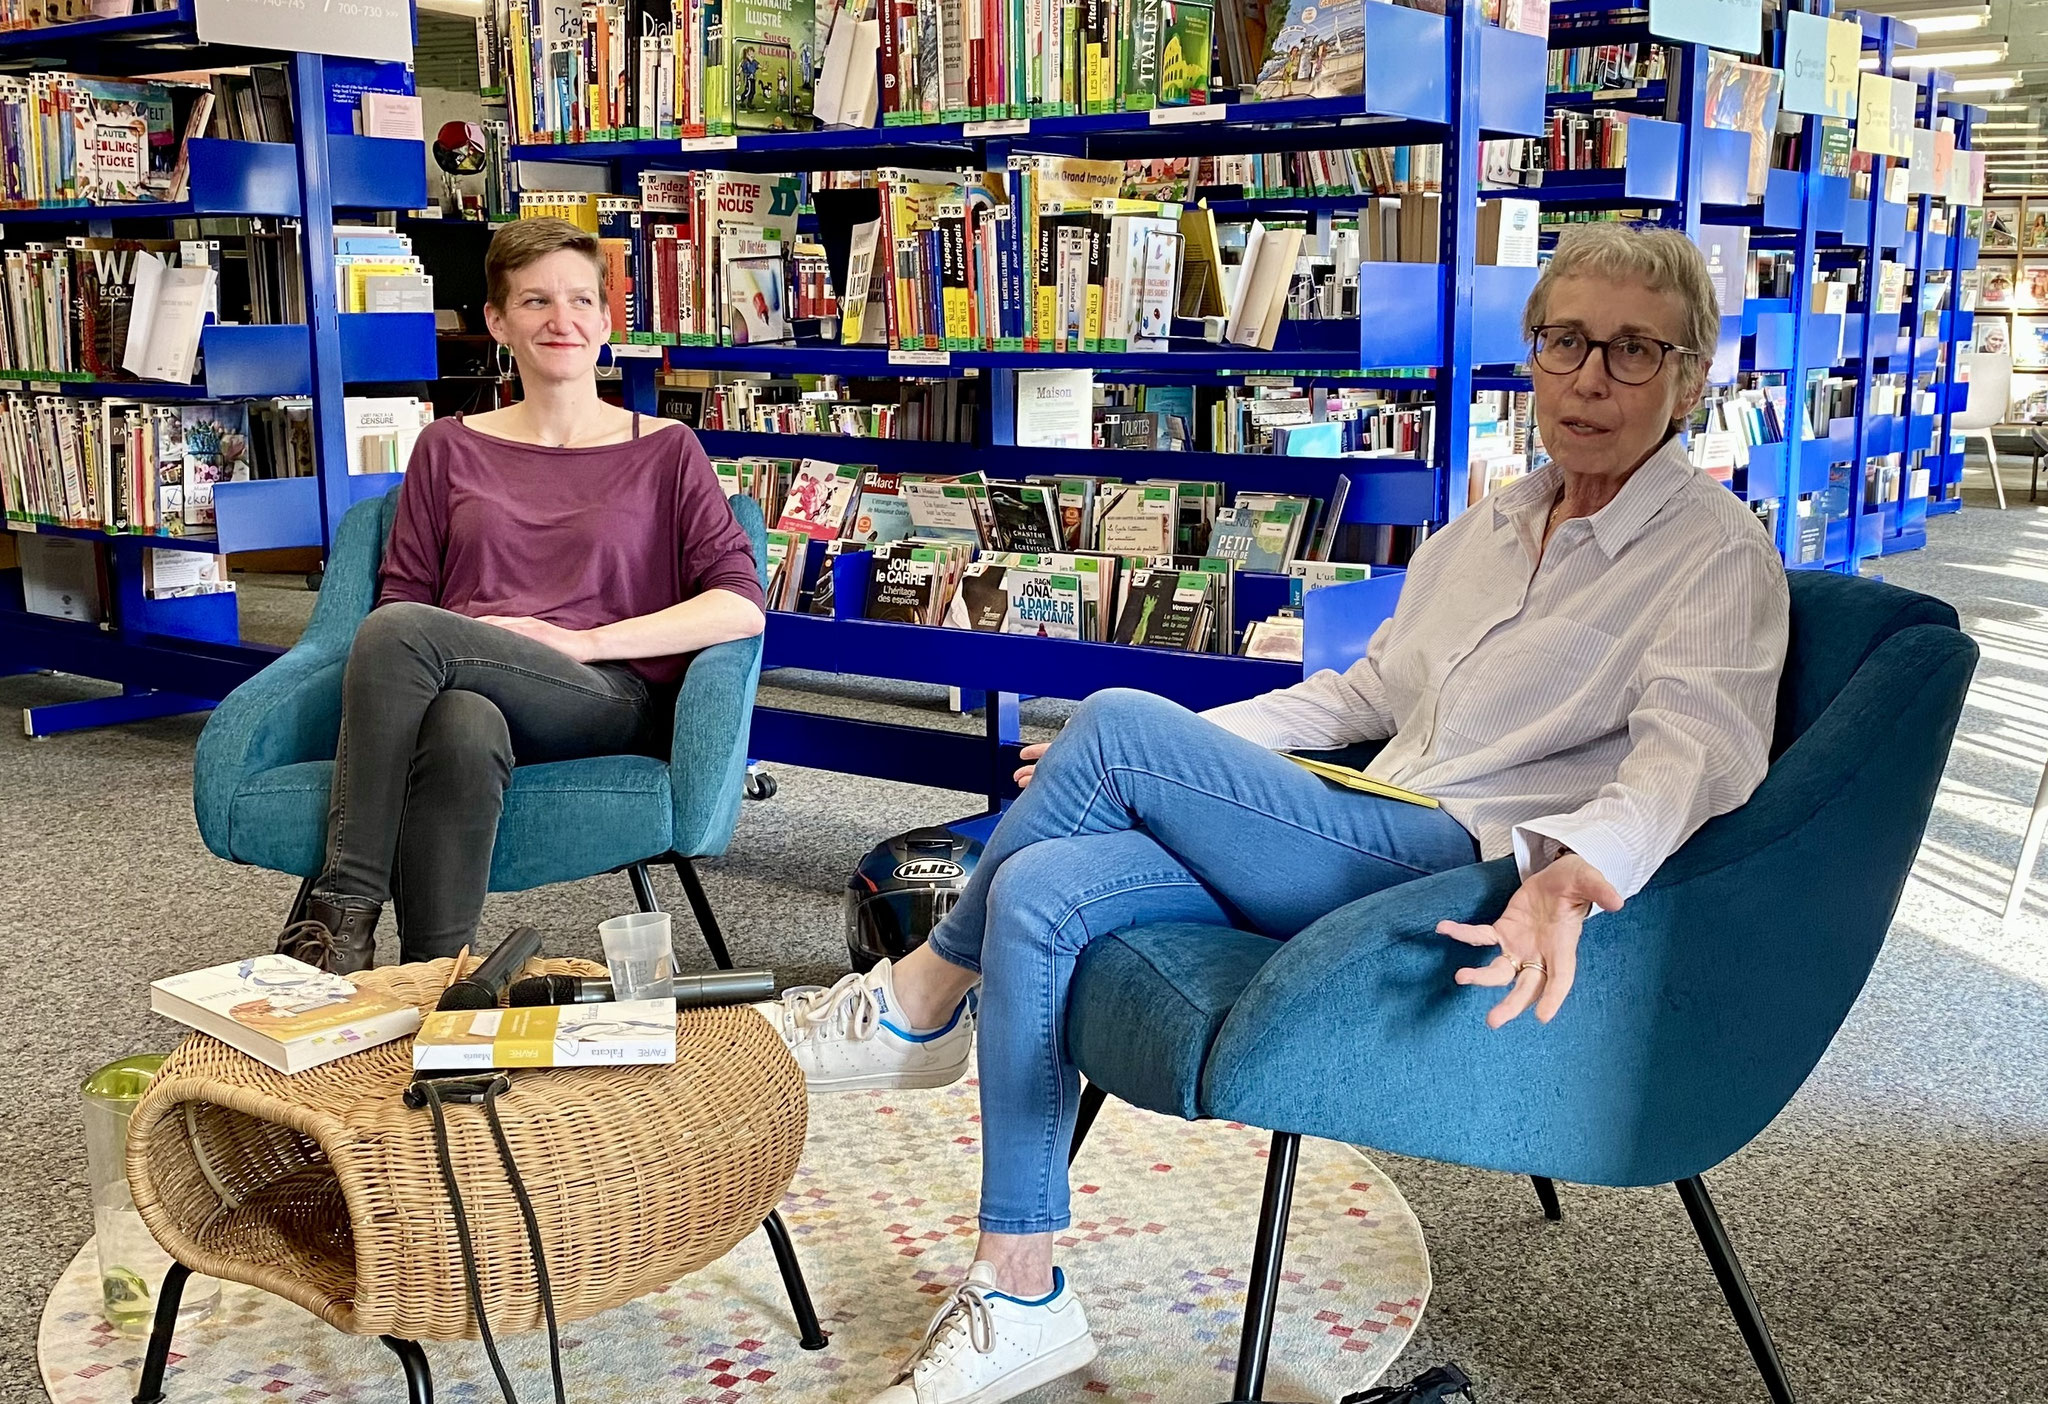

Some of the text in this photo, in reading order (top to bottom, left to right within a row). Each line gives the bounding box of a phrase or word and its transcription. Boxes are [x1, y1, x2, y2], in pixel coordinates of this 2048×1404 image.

[338, 3, 382, 17] 700-730
[735, 0, 792, 11] ONNAIRE
[745, 7, 782, 28] ILLUSTRÉ
[1088, 0, 1097, 29] L'ital
[1794, 49, 1803, 78] 6
[1828, 55, 1836, 83] 5
[149, 107, 164, 121] ELT
[1865, 102, 1873, 125] 5
[1891, 106, 1898, 130] 3
[97, 130, 127, 139] LAUTER
[92, 154, 135, 168] STÜCKE
[1062, 171, 1086, 183] Grand
[1087, 172, 1118, 187] Imagier
[718, 182, 760, 198] ENTRE
[647, 192, 690, 203] en Franc
[718, 198, 754, 213] NOUS
[943, 228, 952, 275] L'espagnol
[954, 224, 966, 281] Le portugais
[1040, 230, 1049, 273] L'hébreu
[1090, 233, 1100, 266] L'arabe
[1036, 386, 1072, 399] Maison
[360, 417, 394, 425] CENSURE
[1121, 419, 1149, 436] TOURTES
[113, 428, 126, 437] PA
[1012, 530, 1046, 539] CHANTENT
[1217, 535, 1254, 550] PETIT
[1239, 551, 1249, 560] DE
[887, 559, 911, 571] JOH
[876, 569, 886, 581] le
[1034, 577, 1051, 585] RAGN
[1316, 573, 1335, 581] L'us
[883, 585, 916, 597] L'héritage
[1021, 581, 1053, 599] JÓNA
[877, 594, 919, 606] des espions
[1012, 595, 1074, 613] LA DAME DE
[1172, 603, 1194, 612] Vercors
[1171, 613, 1191, 621] Silence
[903, 864, 955, 876] HJC
[463, 1051, 492, 1061] Mauris
[509, 1049, 539, 1059] FAVRE
[591, 1048, 624, 1058] Falcata
[637, 1048, 667, 1058] FAVRE
